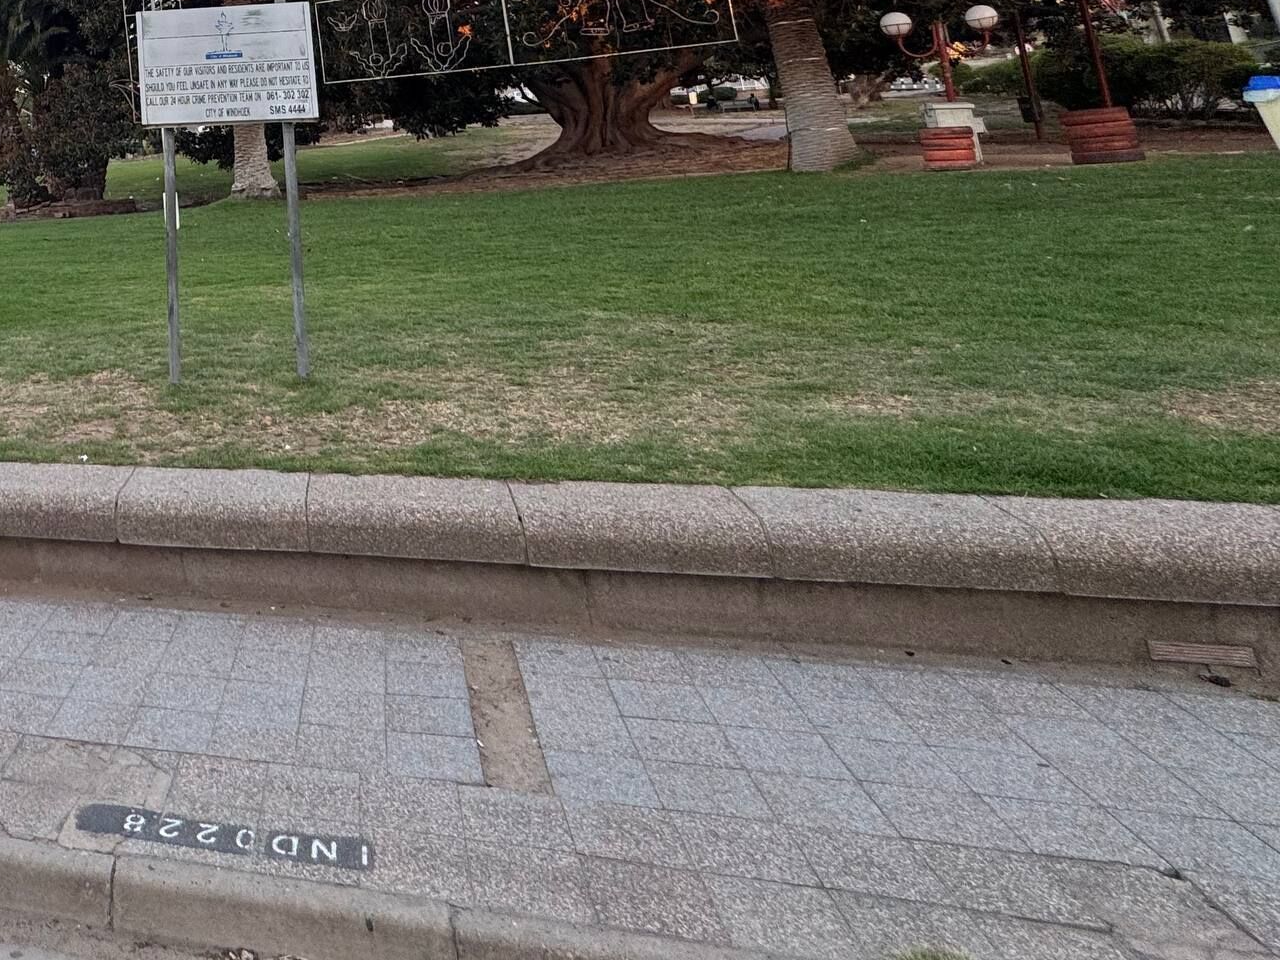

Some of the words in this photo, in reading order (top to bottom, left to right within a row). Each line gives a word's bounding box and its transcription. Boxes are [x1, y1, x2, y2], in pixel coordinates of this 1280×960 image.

[146, 69, 154, 78] THE
[156, 68, 174, 77] SAFETY
[176, 68, 181, 76] OF
[184, 67, 193, 76] OUR
[195, 66, 215, 75] VISITORS
[217, 65, 227, 74] AND
[229, 64, 254, 74] RESIDENTS
[256, 63, 265, 72] ARE
[267, 62, 292, 72] IMPORTANT
[295, 62, 301, 70] TO
[302, 61, 309, 70] US
[146, 83, 164, 92] SHOULD
[166, 82, 175, 91] YOU
[177, 81, 188, 91] FEEL
[190, 80, 208, 90] UNSAFE
[211, 80, 215, 89] IN
[218, 79, 227, 89] ANY
[229, 79, 238, 88] WAY
[240, 78, 258, 88] PLEASE
[261, 77, 267, 86] DO
[269, 77, 277, 86] NOT
[279, 76, 301, 86] HESITATE
[303, 75, 308, 84] TO
[146, 97, 158, 106] CALL
[160, 96, 168, 106] OUR
[171, 96, 176, 105] 24
[178, 95, 190, 105] HOUR
[192, 95, 206, 104] CRIME
[208, 93, 237, 103] PREVENTION
[240, 93, 253, 102] TEAM
[255, 92, 261, 101] ON
[284, 91, 295, 99] 302
[297, 90, 309, 98] 302
[205, 108, 216, 118] CITY
[218, 108, 224, 117] OF
[269, 105, 286, 114] SMS
[288, 104, 306, 113] 4444
